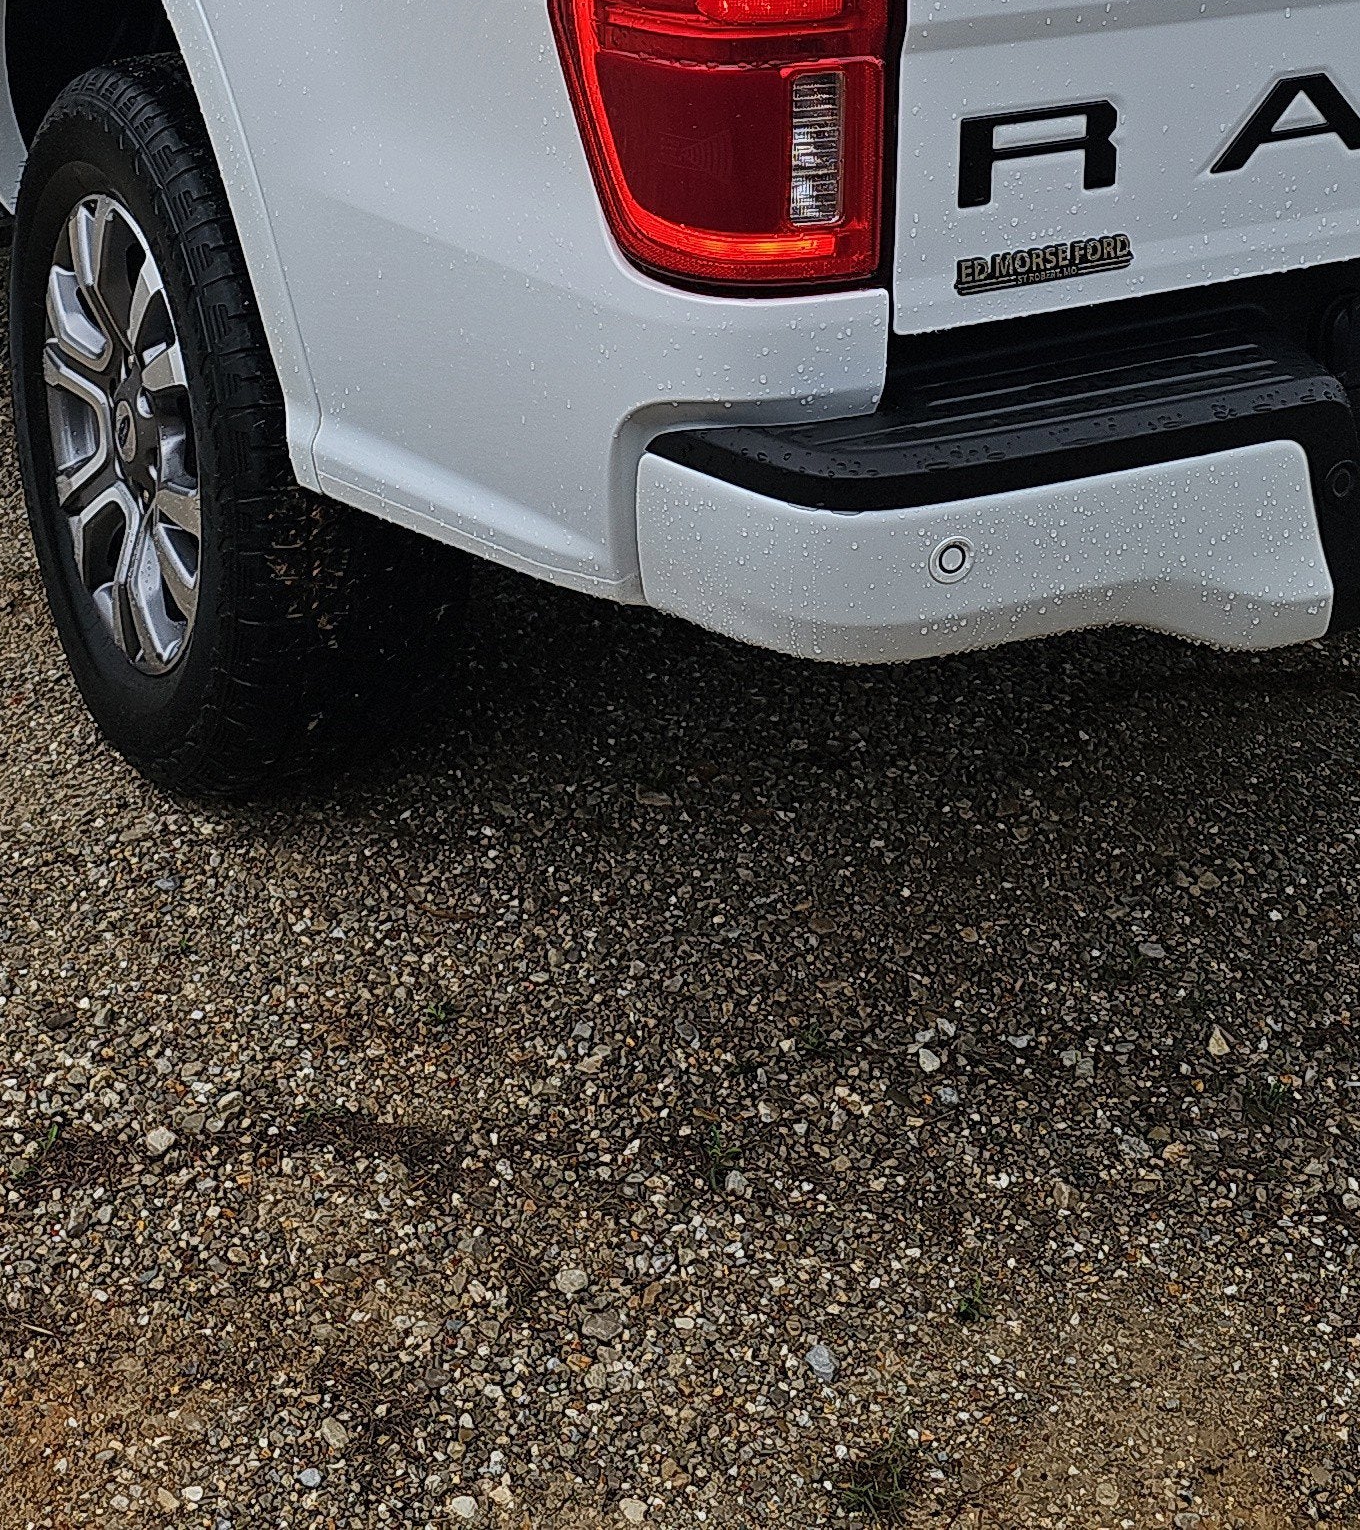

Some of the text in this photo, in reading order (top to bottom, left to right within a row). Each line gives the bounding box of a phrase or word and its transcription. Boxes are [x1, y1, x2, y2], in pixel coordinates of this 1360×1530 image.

[959, 234, 1131, 284] ED MORSE FORD
